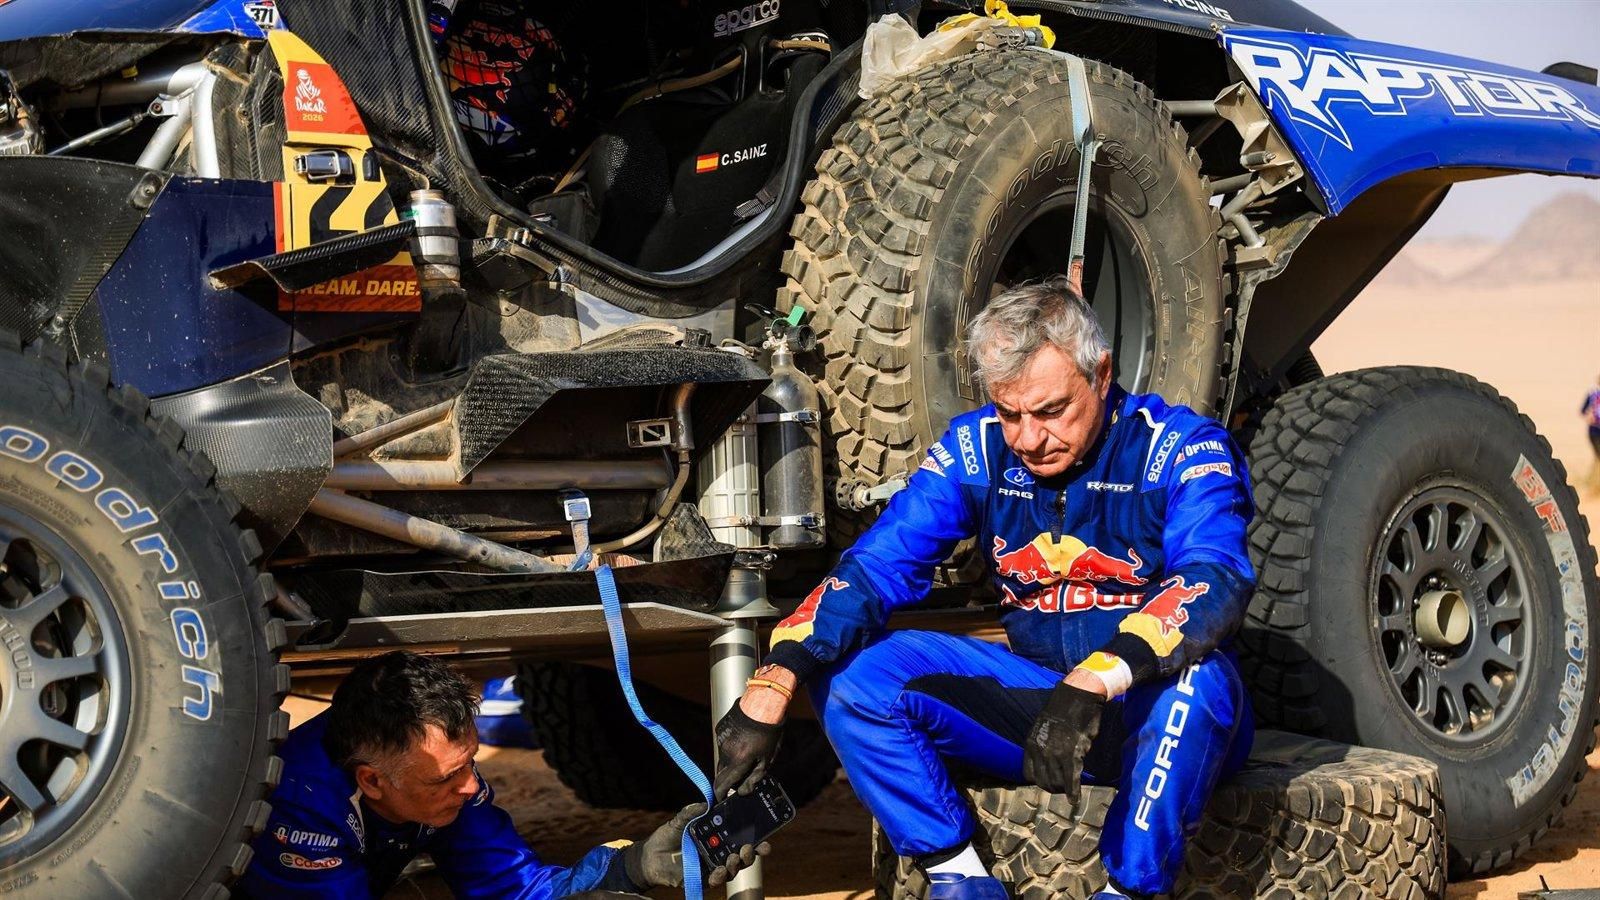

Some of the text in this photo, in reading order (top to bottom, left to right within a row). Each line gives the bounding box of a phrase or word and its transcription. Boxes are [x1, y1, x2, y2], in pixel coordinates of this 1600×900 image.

[251, 8, 274, 23] 371
[714, 0, 780, 36] sparco
[1228, 38, 1600, 140] RAPTOR
[295, 95, 327, 114] DAKAR
[302, 113, 324, 122] 2026
[721, 143, 767, 166] C.SAINZ
[299, 280, 421, 296] REAM. DARE.
[956, 425, 980, 476] sparco
[1147, 431, 1182, 484] sparco
[1185, 440, 1225, 457] OPTIMA
[1134, 699, 1191, 832] FORD
[289, 829, 339, 848] OPTIMA
